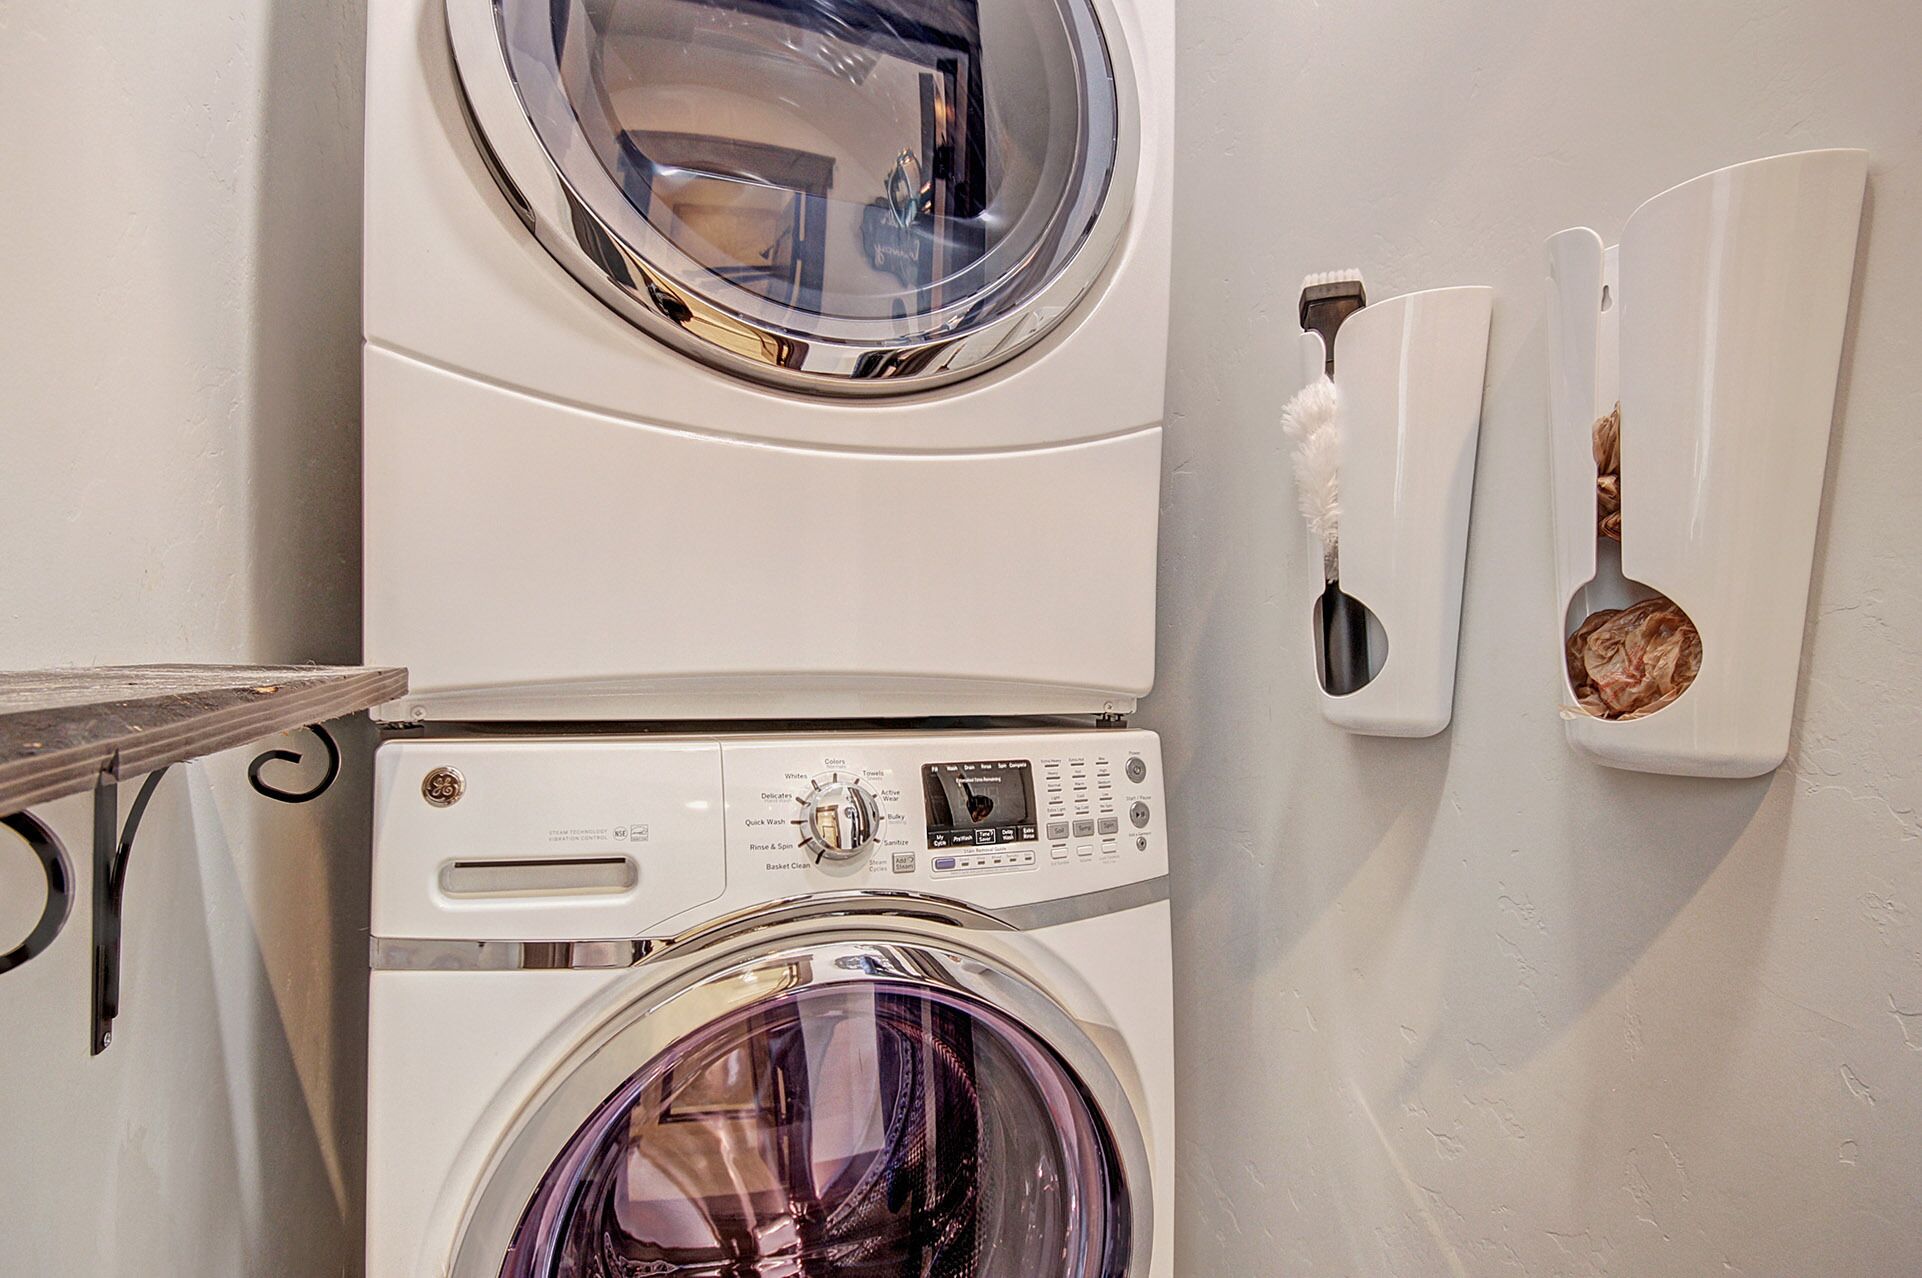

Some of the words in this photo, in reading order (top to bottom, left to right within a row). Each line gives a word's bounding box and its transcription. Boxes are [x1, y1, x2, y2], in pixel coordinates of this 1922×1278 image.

[745, 819, 765, 827] Quick
[766, 818, 786, 826] Wash
[777, 843, 794, 851] Spin
